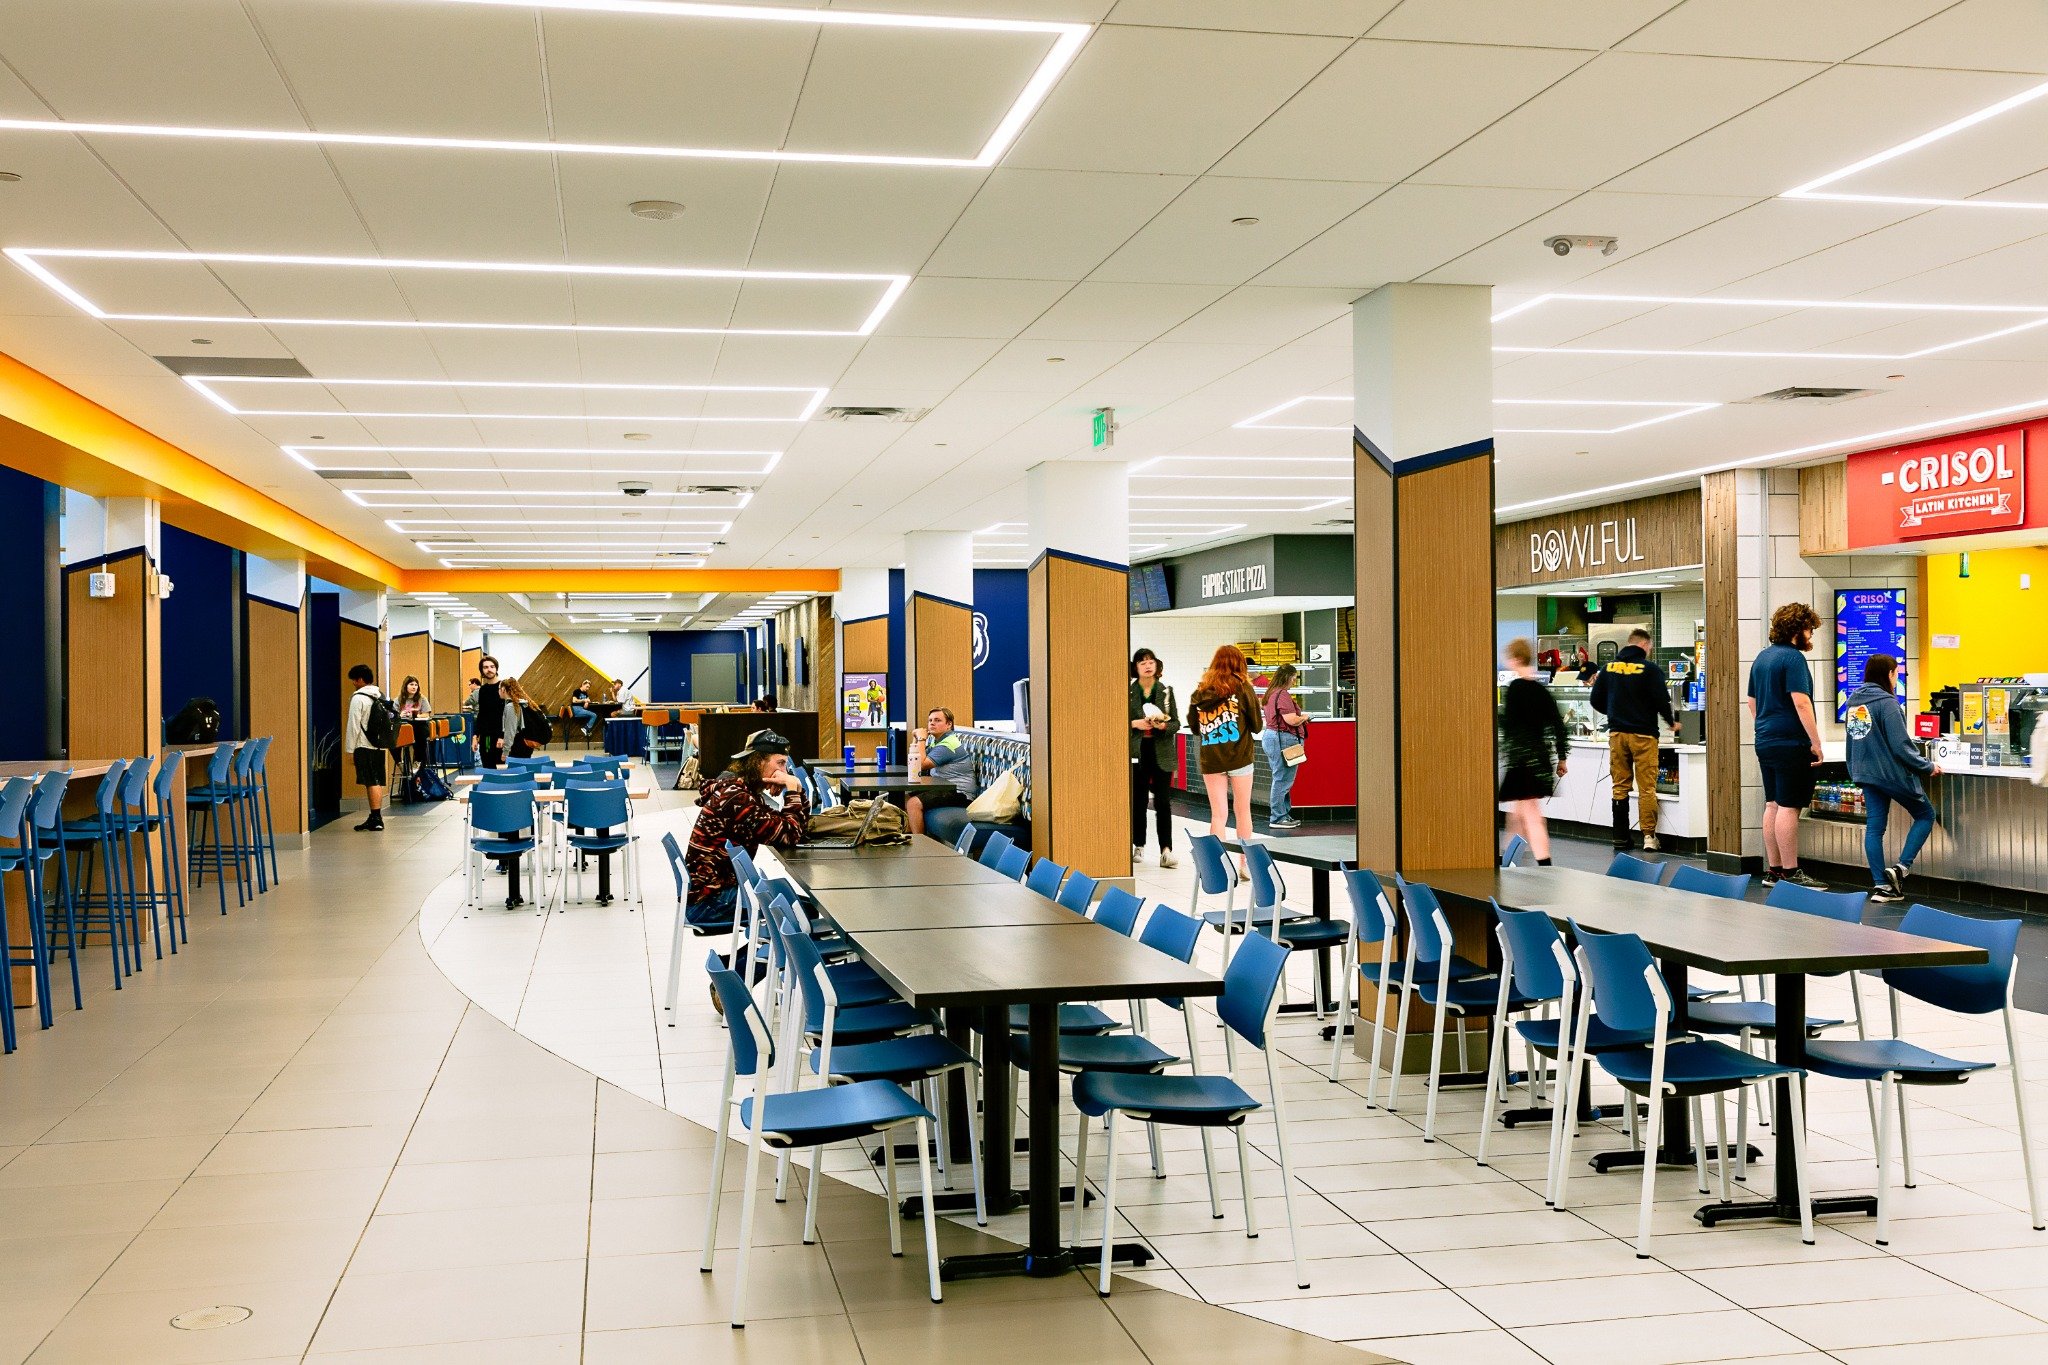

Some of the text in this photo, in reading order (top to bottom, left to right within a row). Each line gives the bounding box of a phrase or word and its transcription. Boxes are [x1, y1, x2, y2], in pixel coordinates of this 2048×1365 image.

[1898, 444, 2014, 493] CRISOL
[1915, 493, 1995, 514] LATIN KITCHEN
[1530, 517, 1645, 573] BOWLFUL
[1201, 571, 1225, 599] EMPIRE
[1225, 567, 1246, 595] STATE
[1246, 564, 1267, 592] PIZZA
[1853, 594, 1890, 604] CRISOL
[1606, 661, 1645, 675] UNC
[1198, 700, 1239, 725] MORE
[1198, 711, 1240, 735] WORRY
[1200, 720, 1240, 746] LESS
